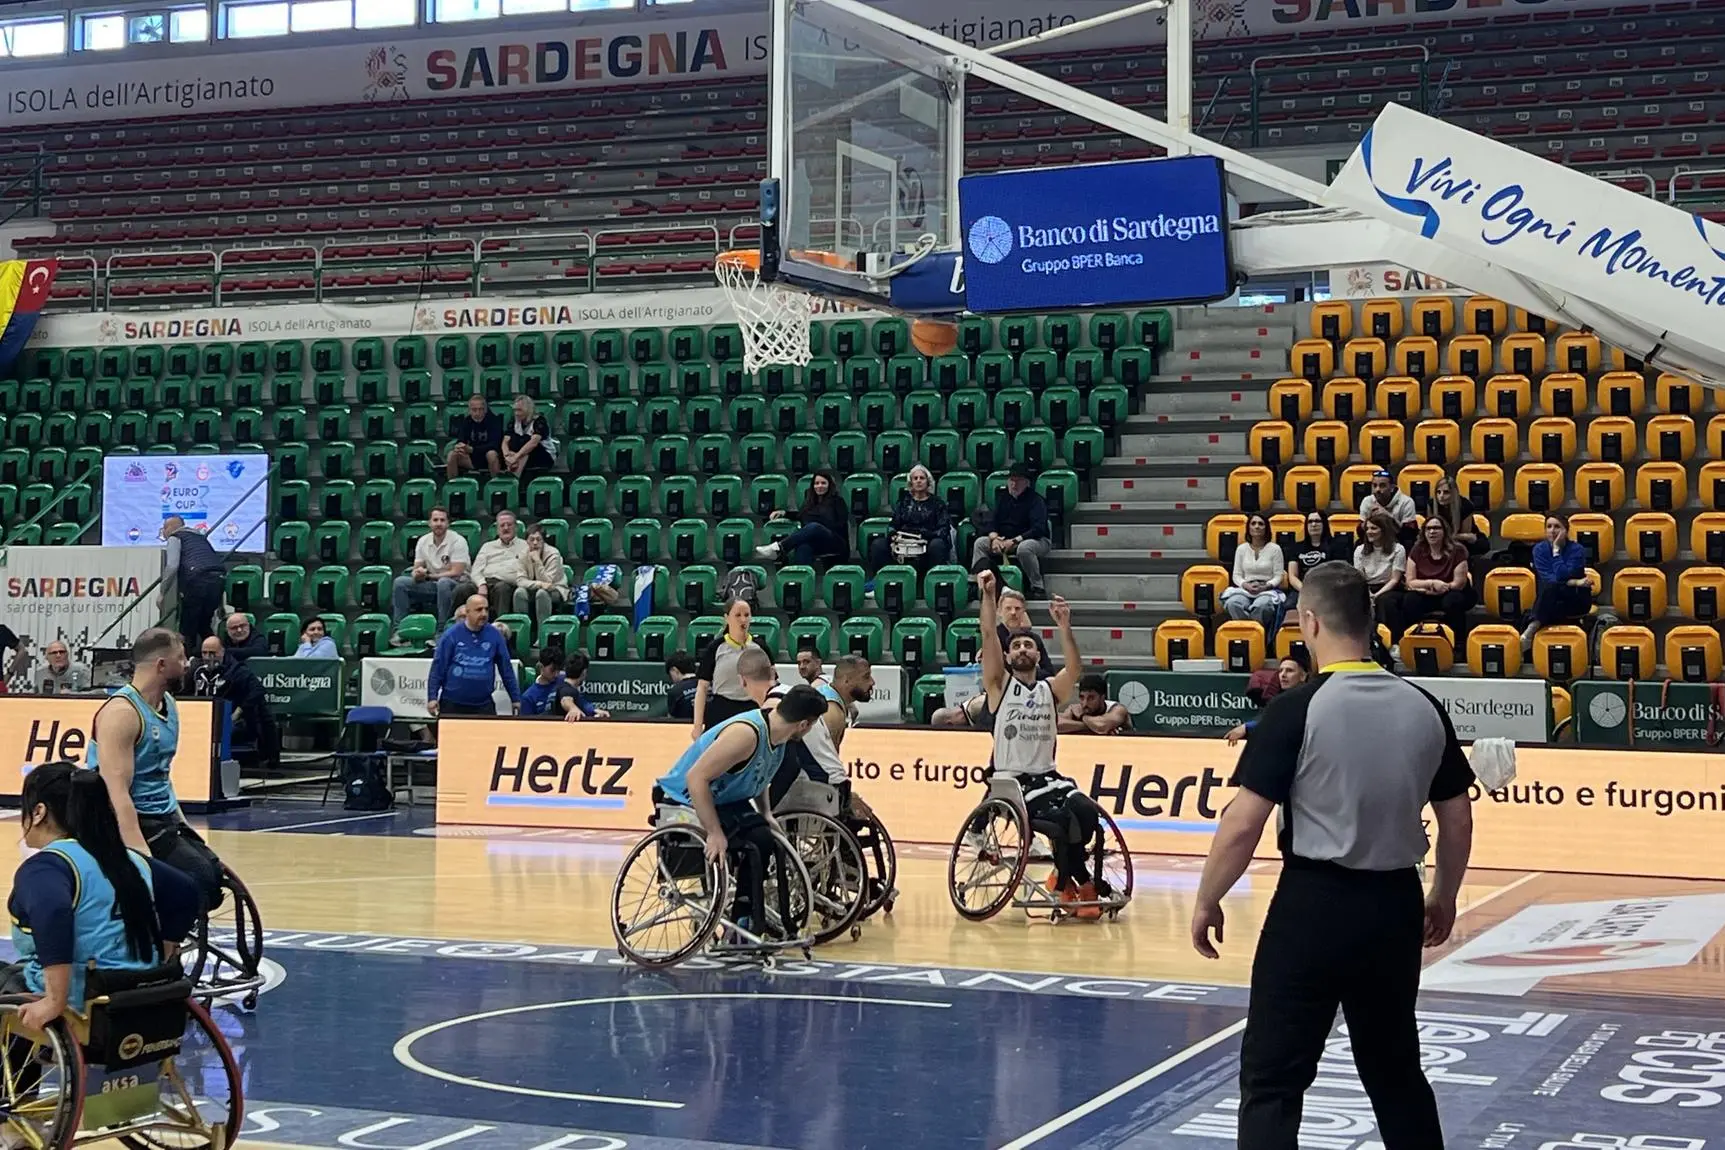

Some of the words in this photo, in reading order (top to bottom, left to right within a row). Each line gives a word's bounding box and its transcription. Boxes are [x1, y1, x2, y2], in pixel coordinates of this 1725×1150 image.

[427, 29, 728, 91] SARDEGNA
[8, 87, 78, 114] ISOLA
[86, 75, 275, 108] dell'Artigianato
[1405, 157, 1482, 204] Vivi
[1481, 184, 1577, 245] Ogni
[1018, 225, 1086, 248] Banco
[1089, 219, 1109, 243] di
[1112, 214, 1220, 241] Sardegna
[1021, 257, 1070, 275] Gruppo
[1072, 254, 1102, 269] BPER
[1105, 251, 1144, 266] Banca
[443, 305, 573, 329] SARDEGNA
[578, 308, 614, 321] ISOLA
[618, 304, 713, 320] dell'Artigianato
[125, 318, 242, 340] SARDEGNA
[249, 320, 282, 333] ISOLA
[173, 487, 199, 498] EURO
[175, 500, 197, 510] CUP
[7, 577, 141, 598] SARDEGNA
[7, 602, 141, 617] sardegnaturismot
[262, 673, 274, 688] di
[275, 672, 331, 691] Sardegna
[399, 675, 427, 691] Banc
[618, 679, 630, 695] di
[632, 679, 675, 696] Sarde
[1154, 690, 1203, 708] Banco
[1204, 691, 1218, 709] di
[1454, 698, 1534, 719] Sardegna
[1154, 713, 1190, 728] Gruppo
[1190, 714, 1213, 726] BPER
[1214, 715, 1241, 727] Banca
[1689, 703, 1705, 721] di
[1454, 723, 1476, 733] anca
[1673, 728, 1699, 740] BPER
[489, 746, 634, 795] Hertz
[890, 762, 905, 781] e
[912, 757, 987, 790] furgo
[1090, 764, 1241, 819] Hert
[1492, 781, 1564, 805] auto
[1576, 786, 1595, 806] e
